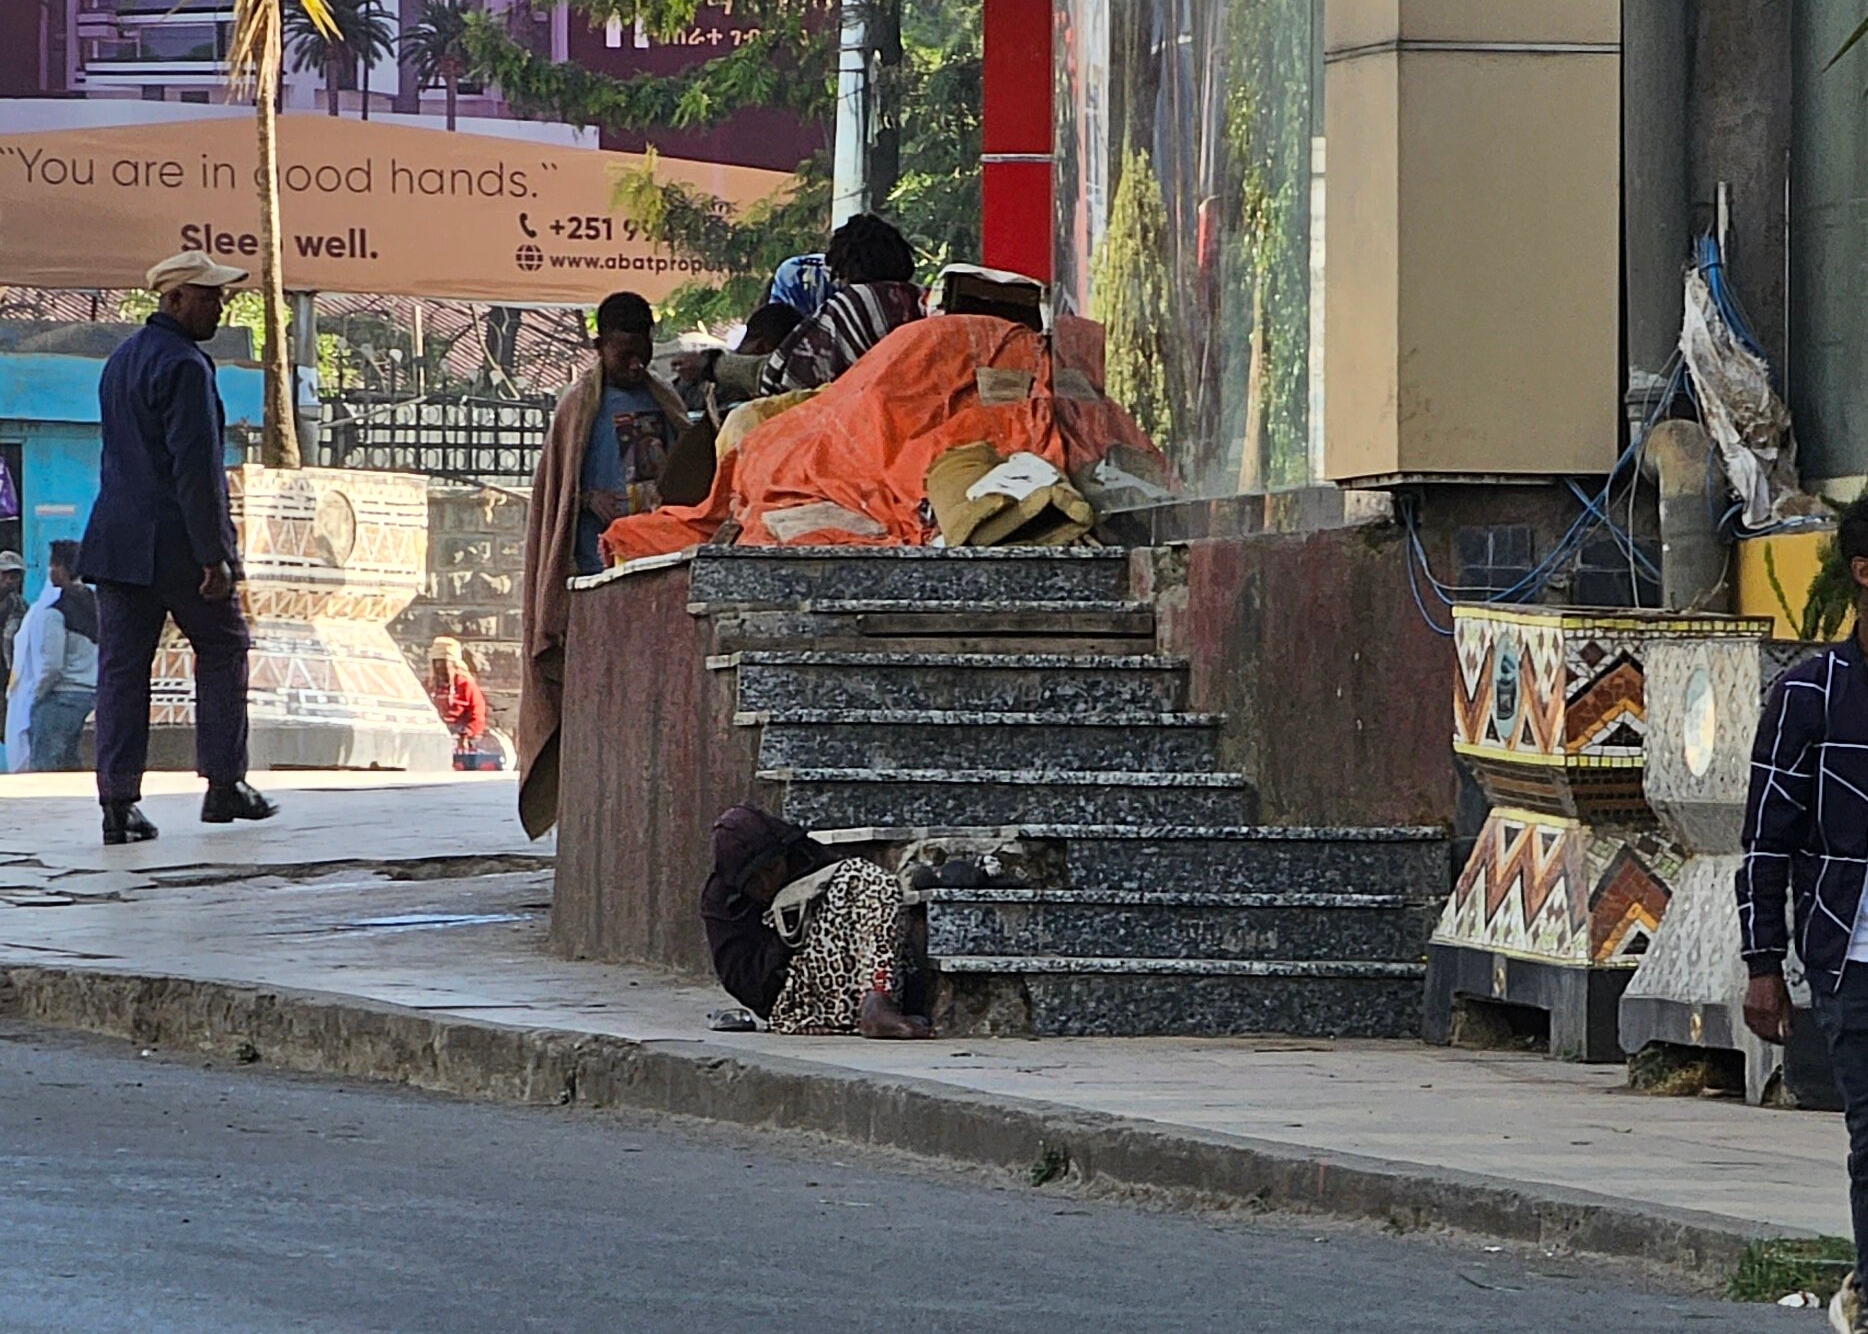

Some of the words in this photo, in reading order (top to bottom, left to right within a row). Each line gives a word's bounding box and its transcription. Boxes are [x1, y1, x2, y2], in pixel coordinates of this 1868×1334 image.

[111, 159, 185, 189] are
[201, 153, 236, 190] in
[180, 222, 284, 256] Slee
[294, 227, 379, 260] well.
[548, 216, 613, 242] +251
